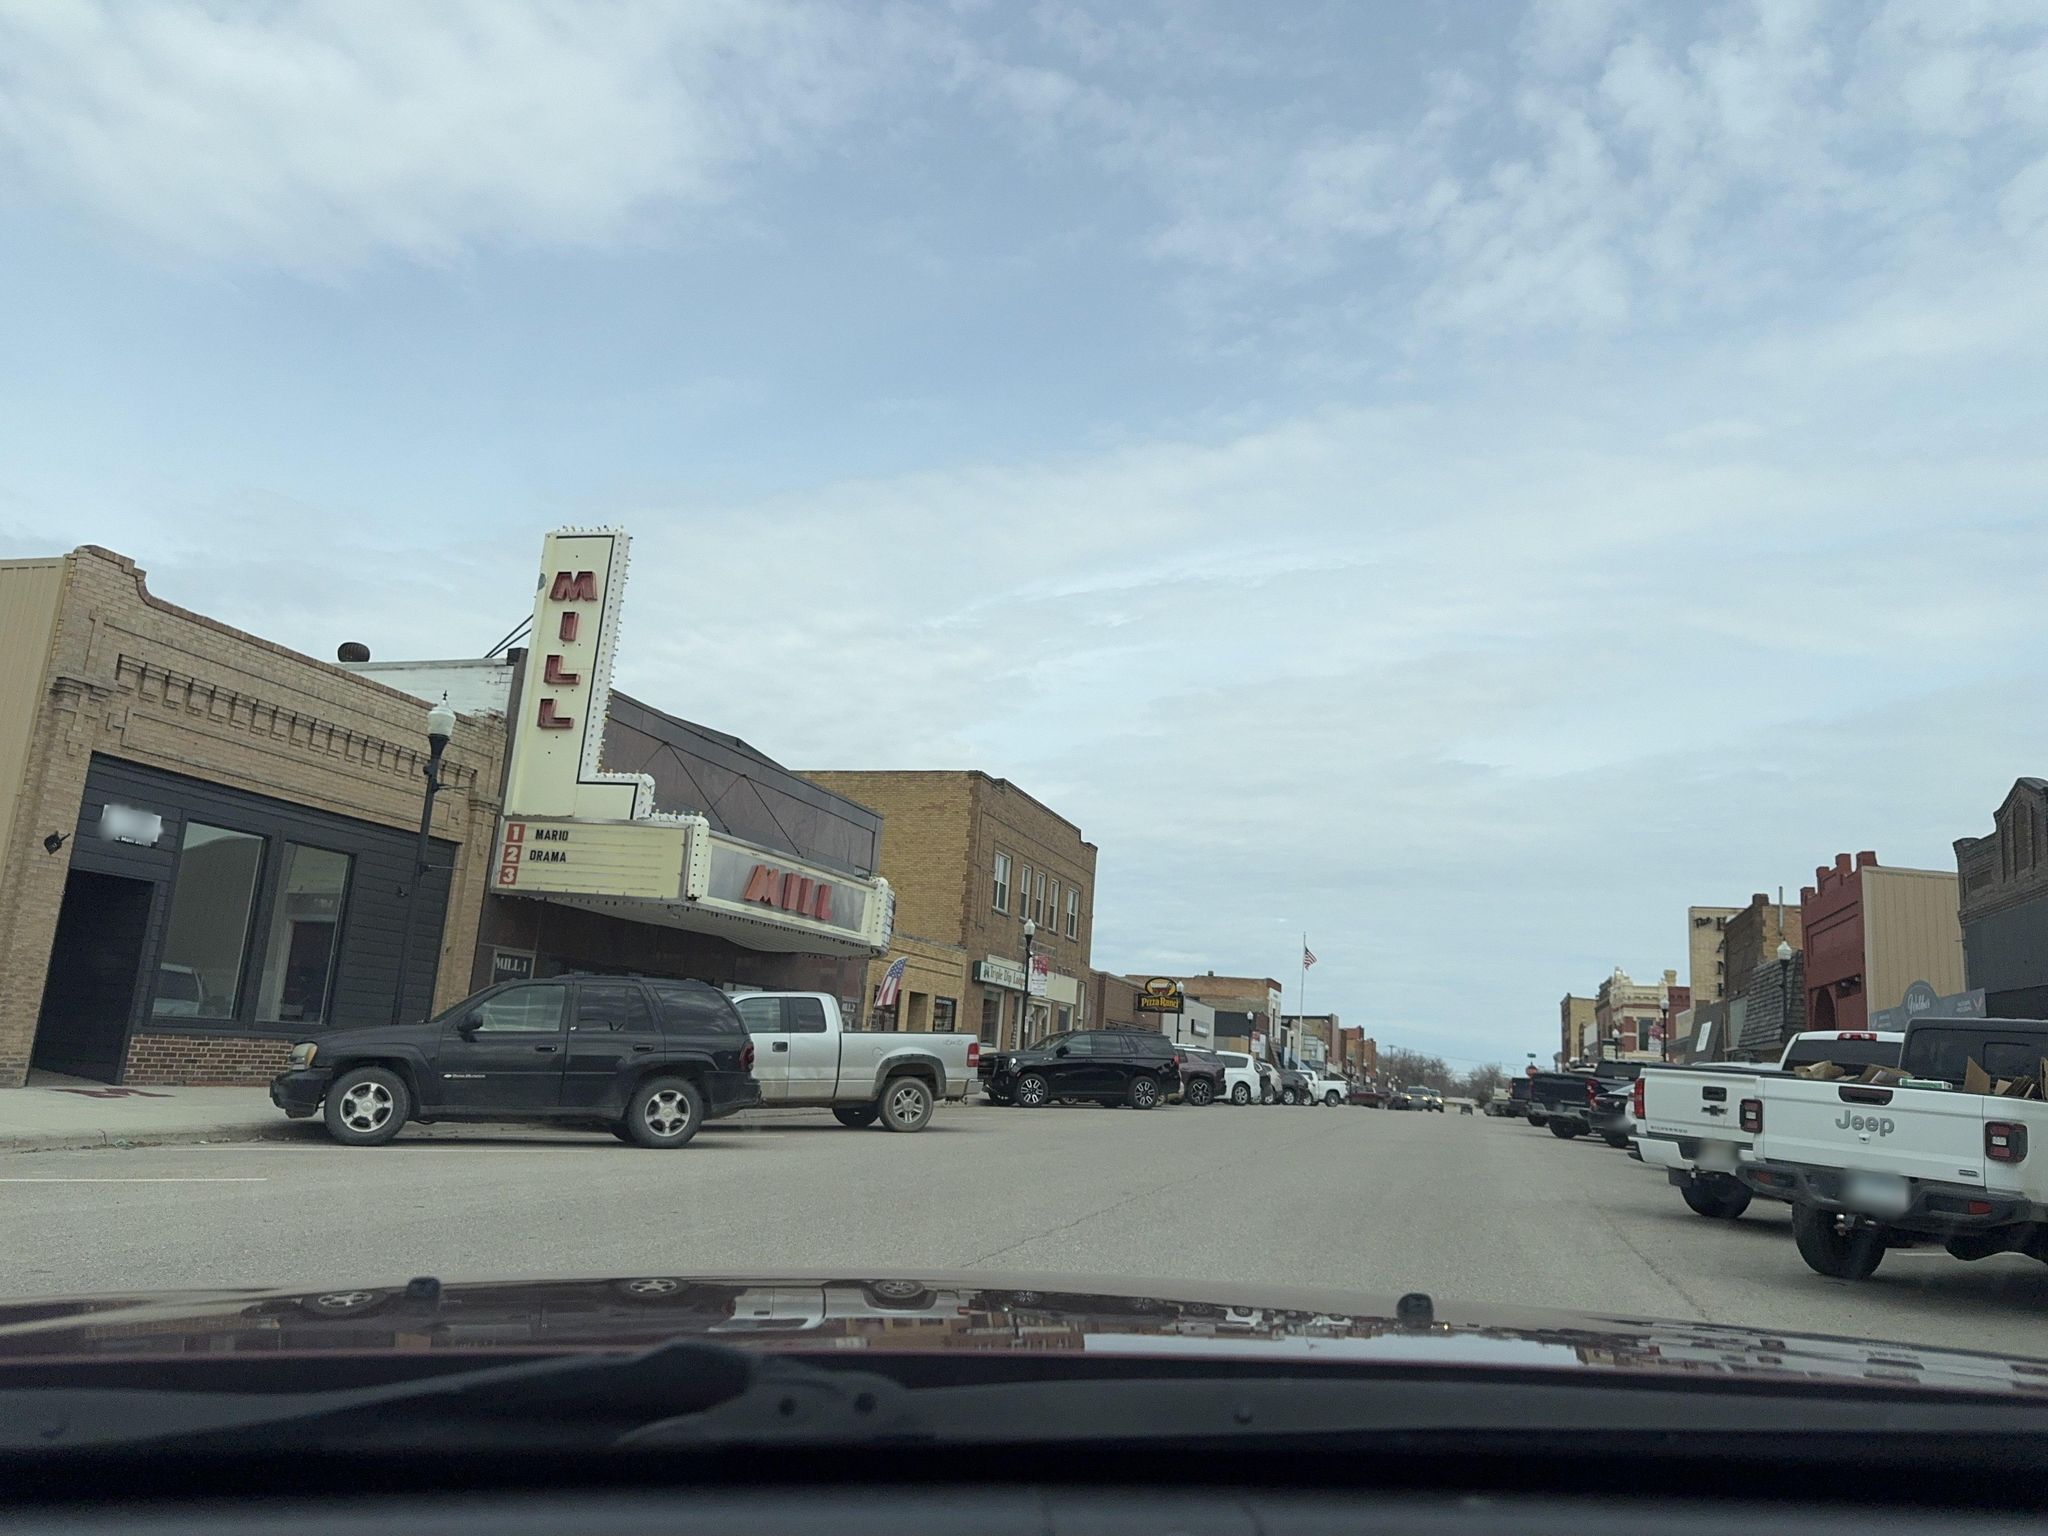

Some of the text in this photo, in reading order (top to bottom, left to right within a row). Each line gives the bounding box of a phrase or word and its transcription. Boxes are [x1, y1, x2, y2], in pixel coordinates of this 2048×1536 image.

[537, 570, 598, 729] MILL
[513, 826, 569, 842] 1 MARIO
[506, 846, 566, 863] 2 DRAMA
[502, 867, 515, 882] 3
[1013, 971, 1025, 988] Lodg
[1141, 997, 1159, 1008] Pizza
[1835, 1109, 1895, 1137] Jeep
